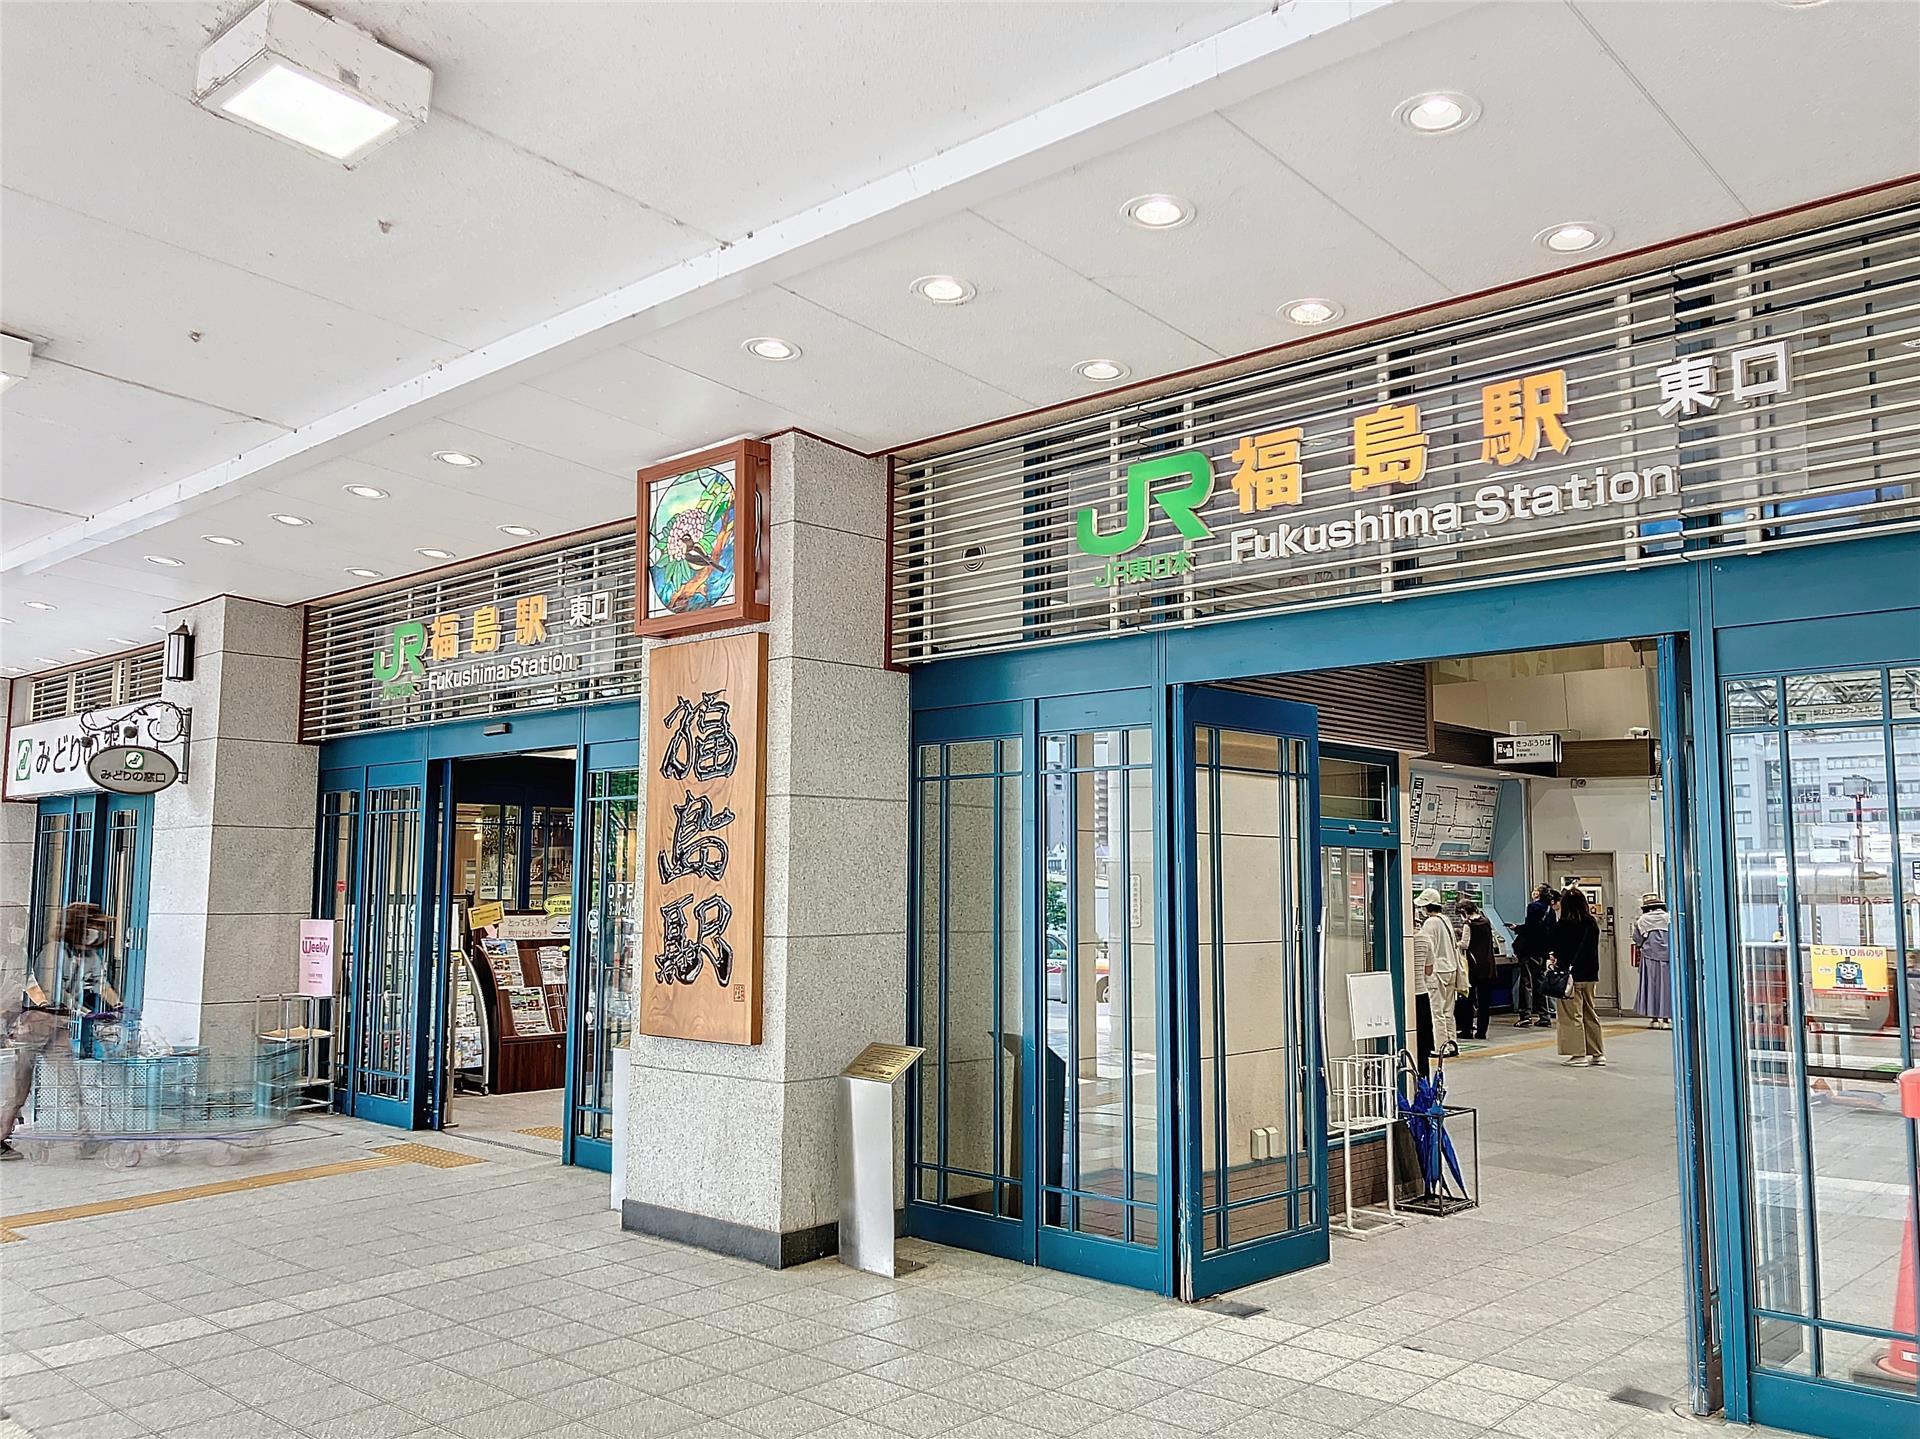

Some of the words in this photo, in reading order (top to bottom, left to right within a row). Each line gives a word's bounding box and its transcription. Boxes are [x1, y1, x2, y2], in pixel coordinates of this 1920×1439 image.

[1077, 450, 1215, 557] JR
[1231, 369, 1572, 514] 福島駅
[1656, 340, 1793, 418] 東口
[1230, 503, 1461, 563] Fukushima
[1475, 463, 1680, 525] Station
[1093, 549, 1196, 588] JR東日本
[373, 621, 428, 681] JR
[430, 595, 548, 662] 福島駅
[569, 592, 613, 627] 東口
[428, 663, 511, 692] Fukushima
[511, 652, 579, 681] Station
[1515, 738, 1552, 748] きっぷうりば
[100, 769, 167, 784] みどりの窓口
[654, 689, 740, 988] 福島駅
[607, 883, 634, 899] OPE
[302, 940, 330, 956] Weekly
